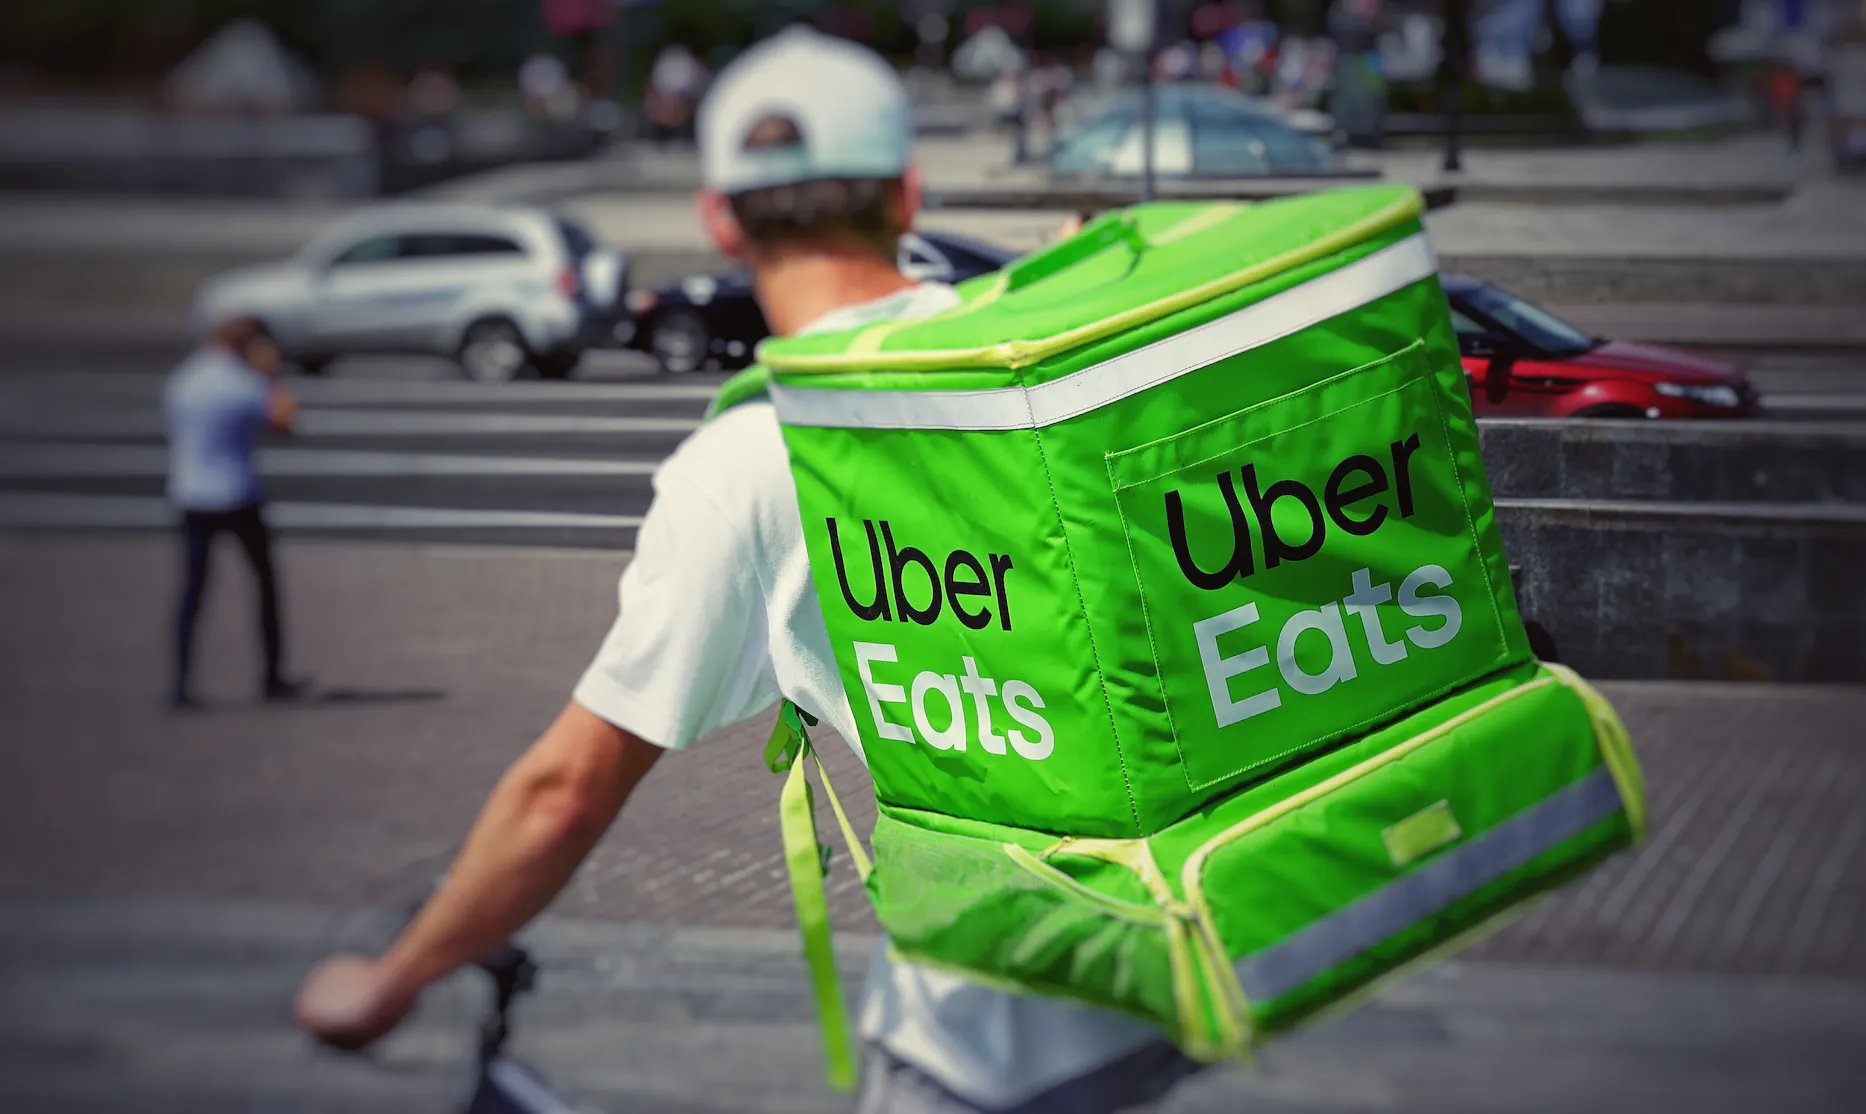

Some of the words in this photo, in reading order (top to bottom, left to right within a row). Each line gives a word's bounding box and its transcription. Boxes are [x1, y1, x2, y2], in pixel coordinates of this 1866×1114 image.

[825, 517, 1014, 631] Uber
[1165, 432, 1420, 590] Uber
[853, 641, 1055, 761] Eats
[1193, 564, 1462, 728] Eats
